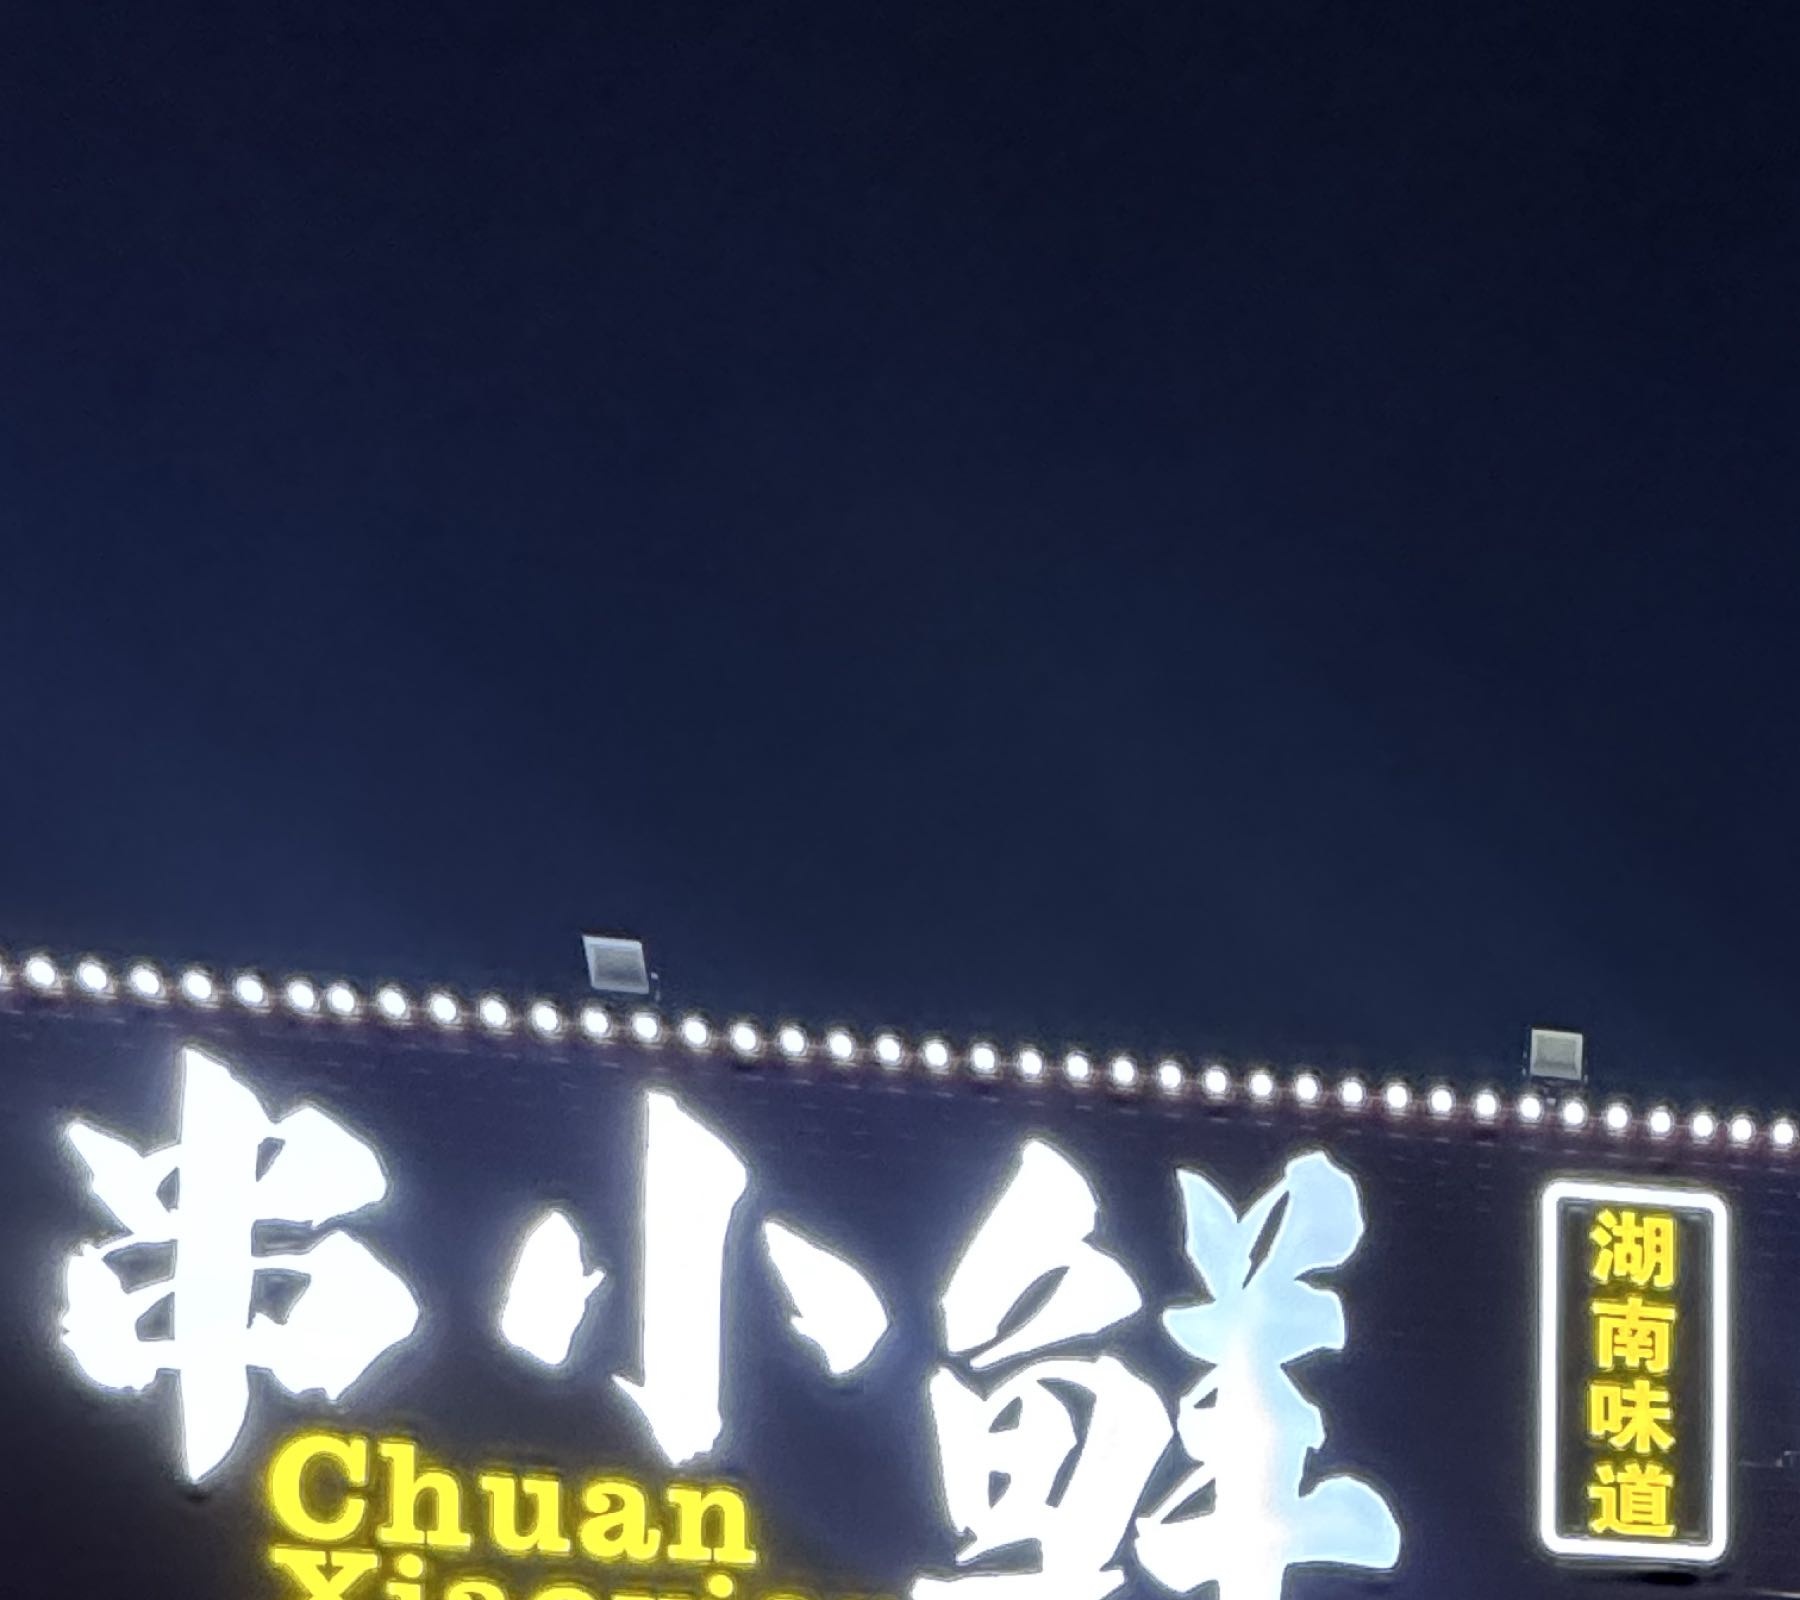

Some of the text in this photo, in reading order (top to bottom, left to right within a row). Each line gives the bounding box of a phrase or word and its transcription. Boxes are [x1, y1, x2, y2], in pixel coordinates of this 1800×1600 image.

[1588, 1208, 1677, 1538] 湖南味道
[267, 1431, 758, 1566] Chuan
